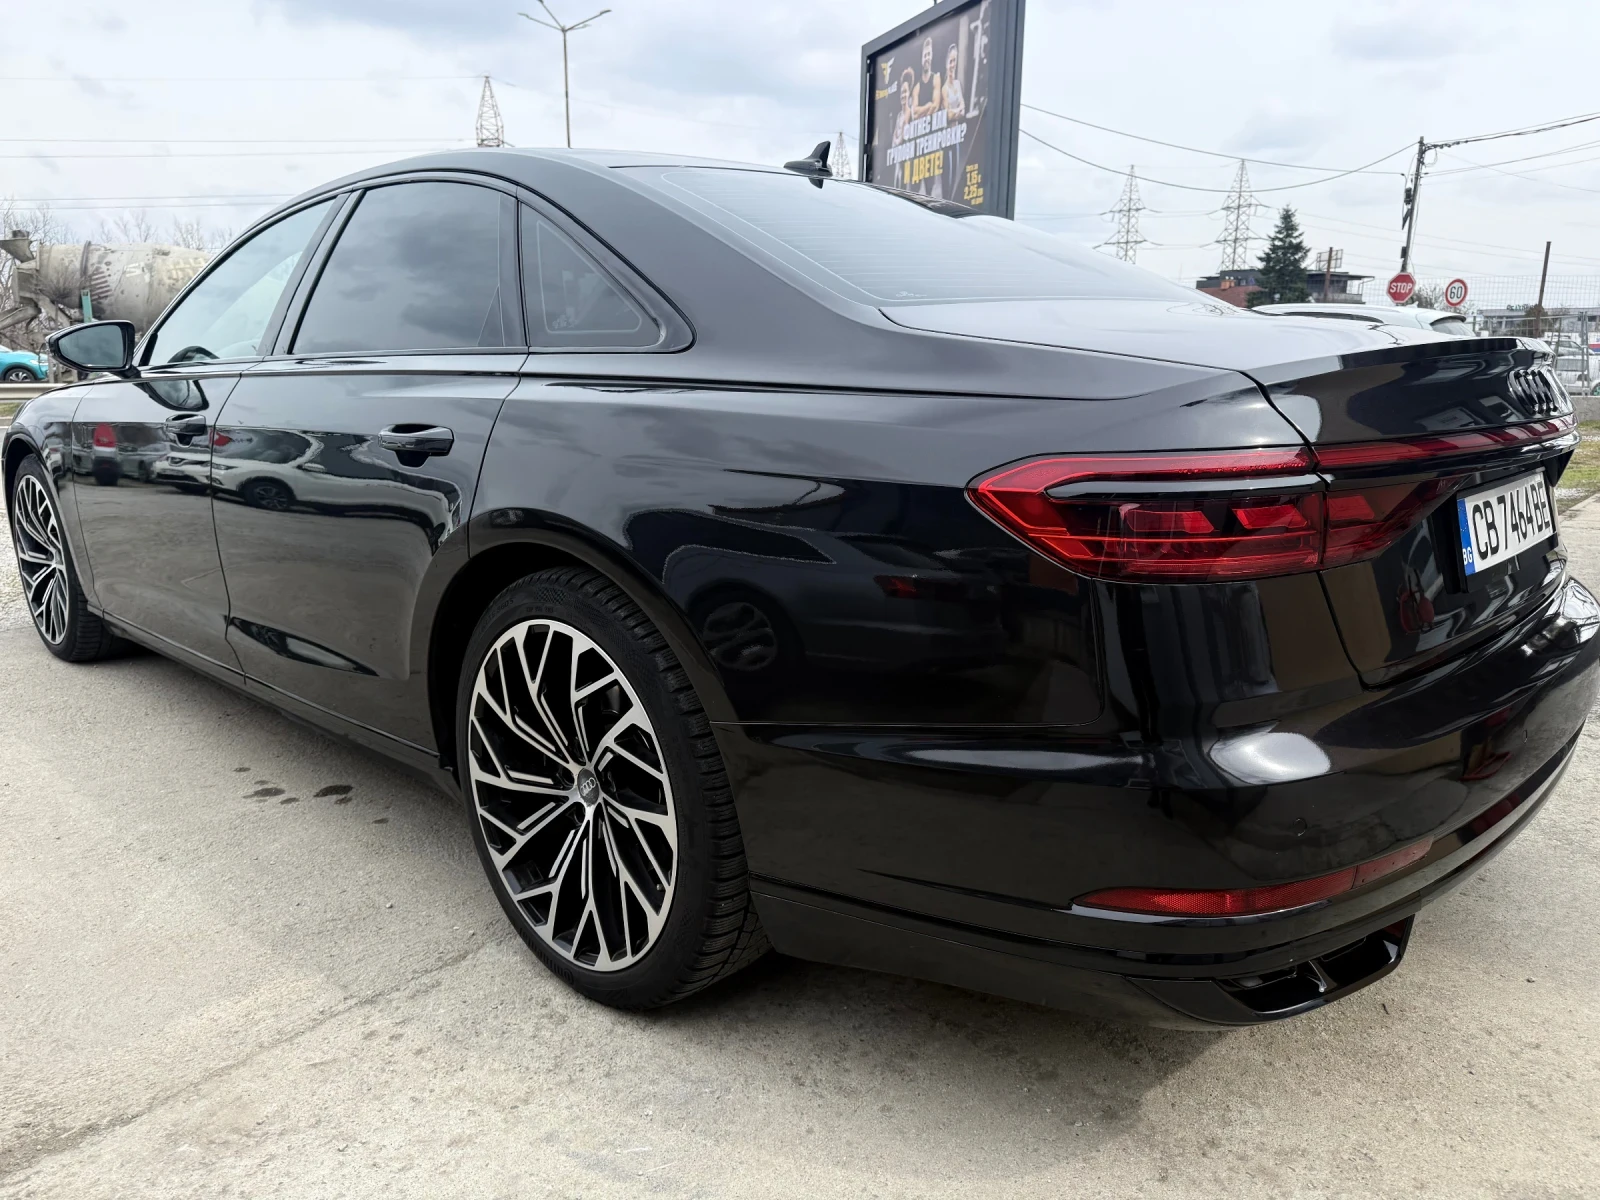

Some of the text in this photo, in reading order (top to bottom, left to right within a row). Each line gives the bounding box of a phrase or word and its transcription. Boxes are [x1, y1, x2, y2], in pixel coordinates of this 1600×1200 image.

[904, 150, 944, 184] И ДВЕТЕ!
[1389, 282, 1413, 293] STOP
[1449, 286, 1463, 299] 60
[1462, 546, 1473, 565] BG
